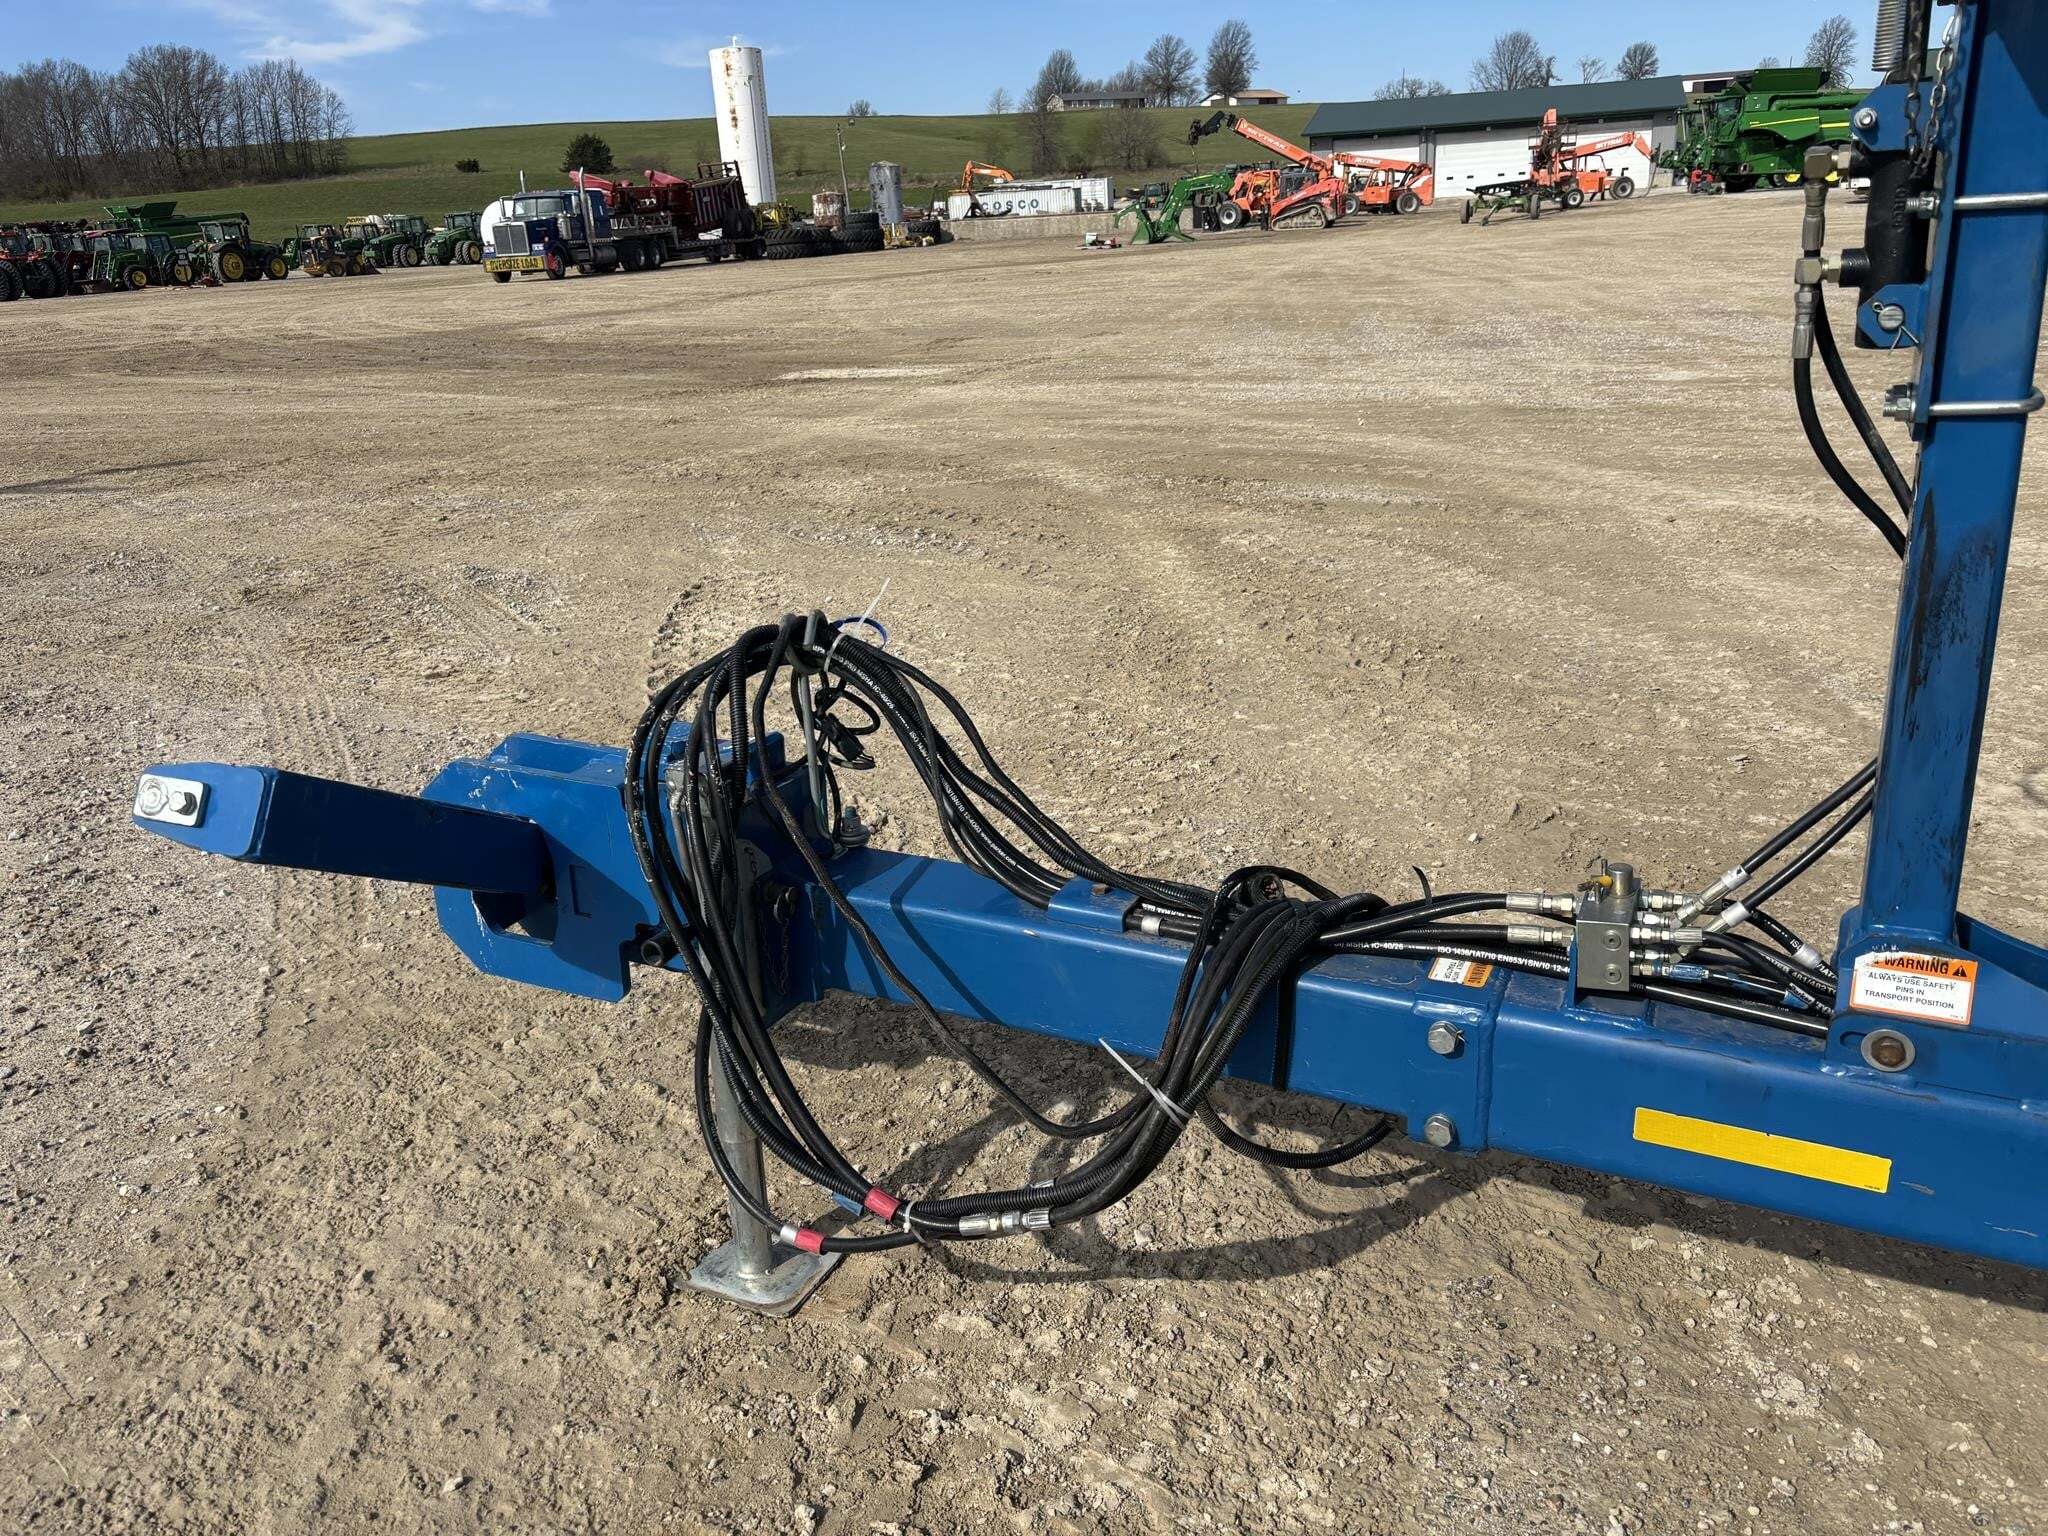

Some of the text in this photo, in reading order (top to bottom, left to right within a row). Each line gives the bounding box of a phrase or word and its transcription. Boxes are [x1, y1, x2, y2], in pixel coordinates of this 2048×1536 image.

[981, 198, 1039, 211] COSCO
[489, 256, 539, 271] OVERSIZE LOAD
[1437, 945, 1451, 955] ISO
[1884, 956, 1950, 976] WARNING
[1867, 971, 1956, 991] ALWAYS USE SAFETY
[1895, 985, 1925, 996] PINS IN
[1864, 989, 1955, 1010] TRANSPORT POSITION
